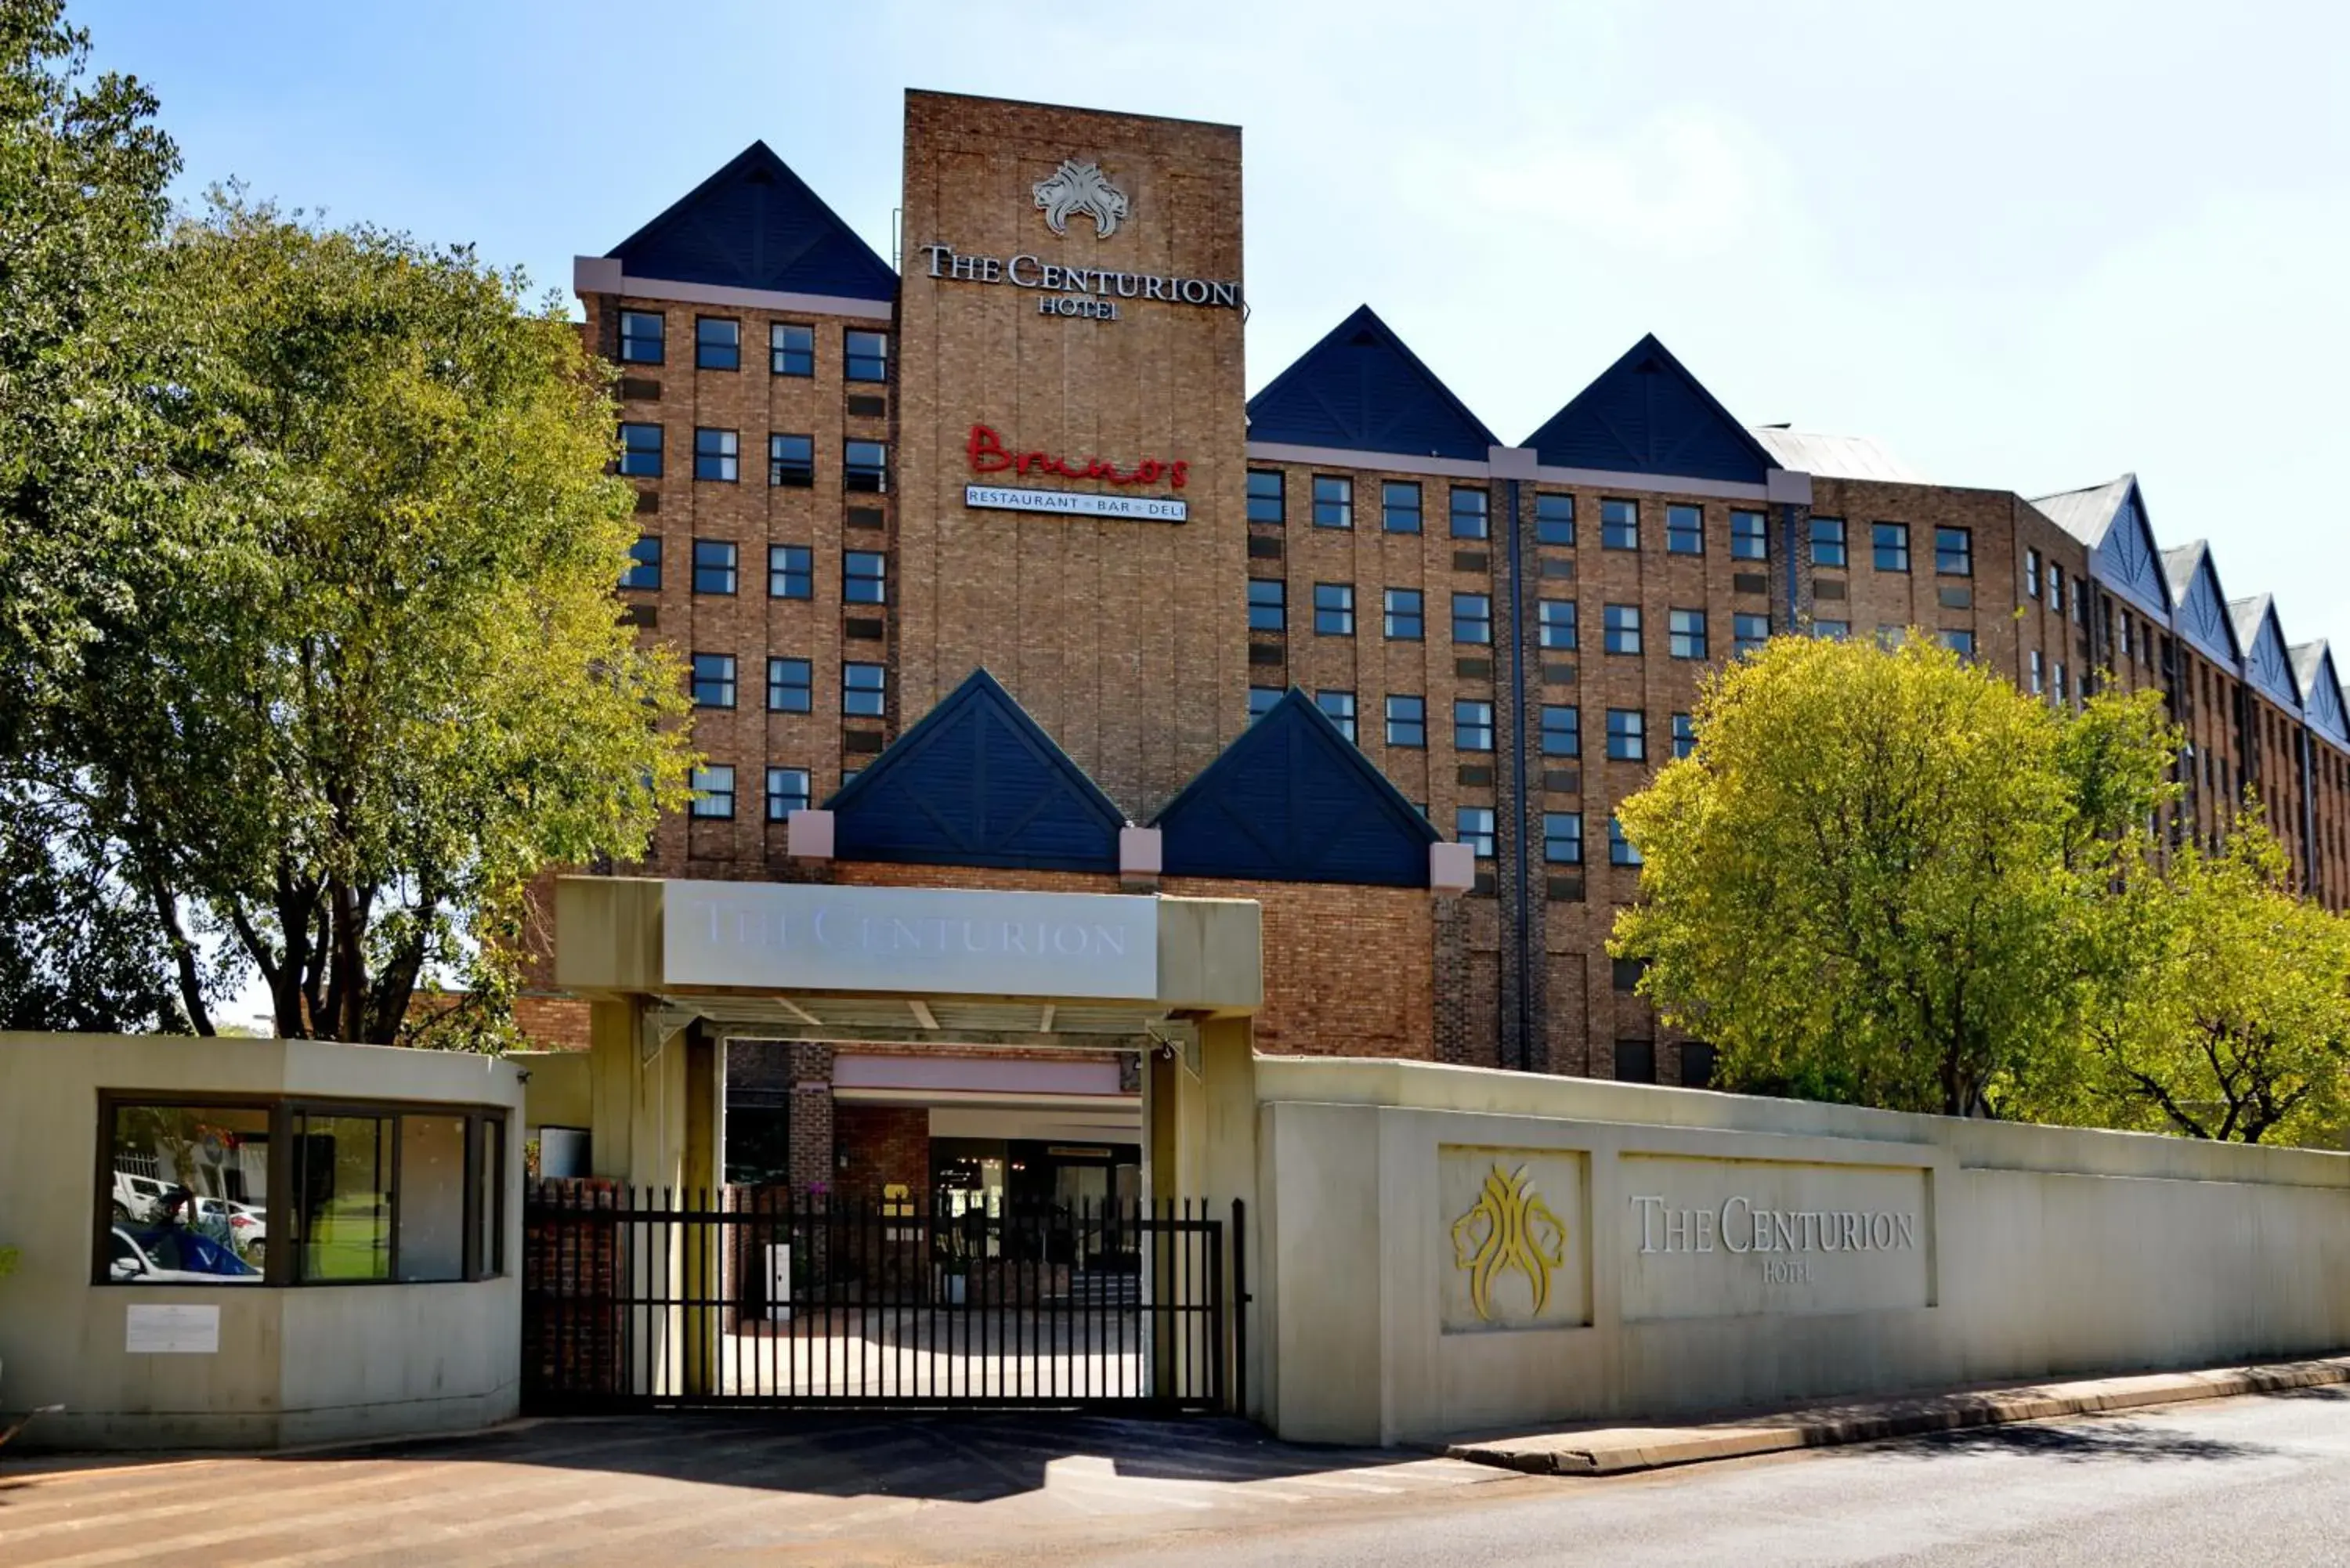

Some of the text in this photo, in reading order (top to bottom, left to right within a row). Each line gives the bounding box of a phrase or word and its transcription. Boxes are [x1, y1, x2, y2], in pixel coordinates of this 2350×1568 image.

[920, 244, 1241, 306] THE CENTURION
[969, 490, 1184, 517] RESTAURANT BAR DELI
[1629, 1194, 1916, 1254] THE CENTURION
